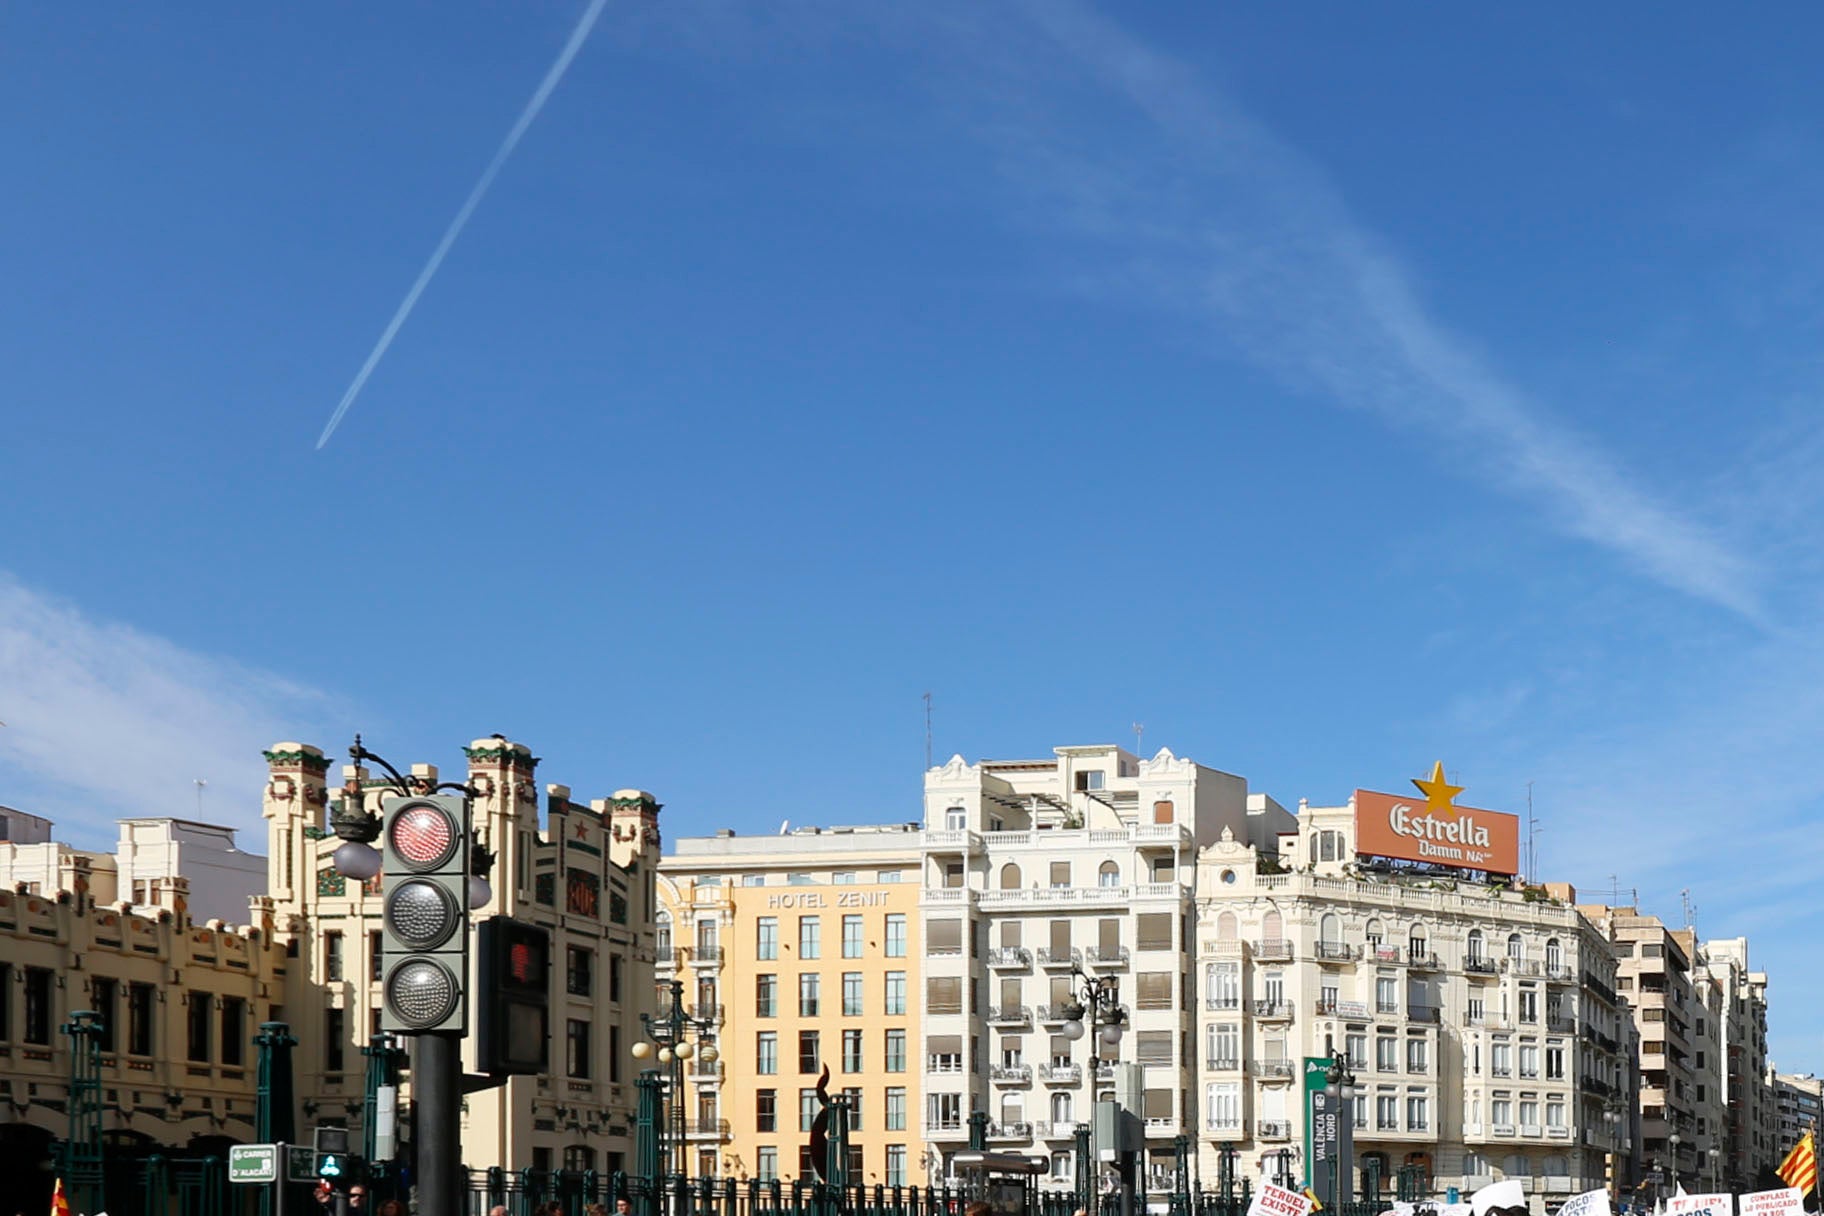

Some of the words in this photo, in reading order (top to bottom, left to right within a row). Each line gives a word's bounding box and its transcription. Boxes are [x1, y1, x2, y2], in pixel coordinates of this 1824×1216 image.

[1389, 802, 1490, 848] Estrella
[1418, 839, 1462, 861] Damm
[769, 893, 828, 909] HOTEL
[837, 891, 890, 908] ZENIT
[1314, 1113, 1326, 1161] VALÈNCIA
[1326, 1113, 1336, 1141] NORD
[1264, 1185, 1306, 1210] TERUEL
[1755, 1199, 1798, 1210] PUBLICADO
